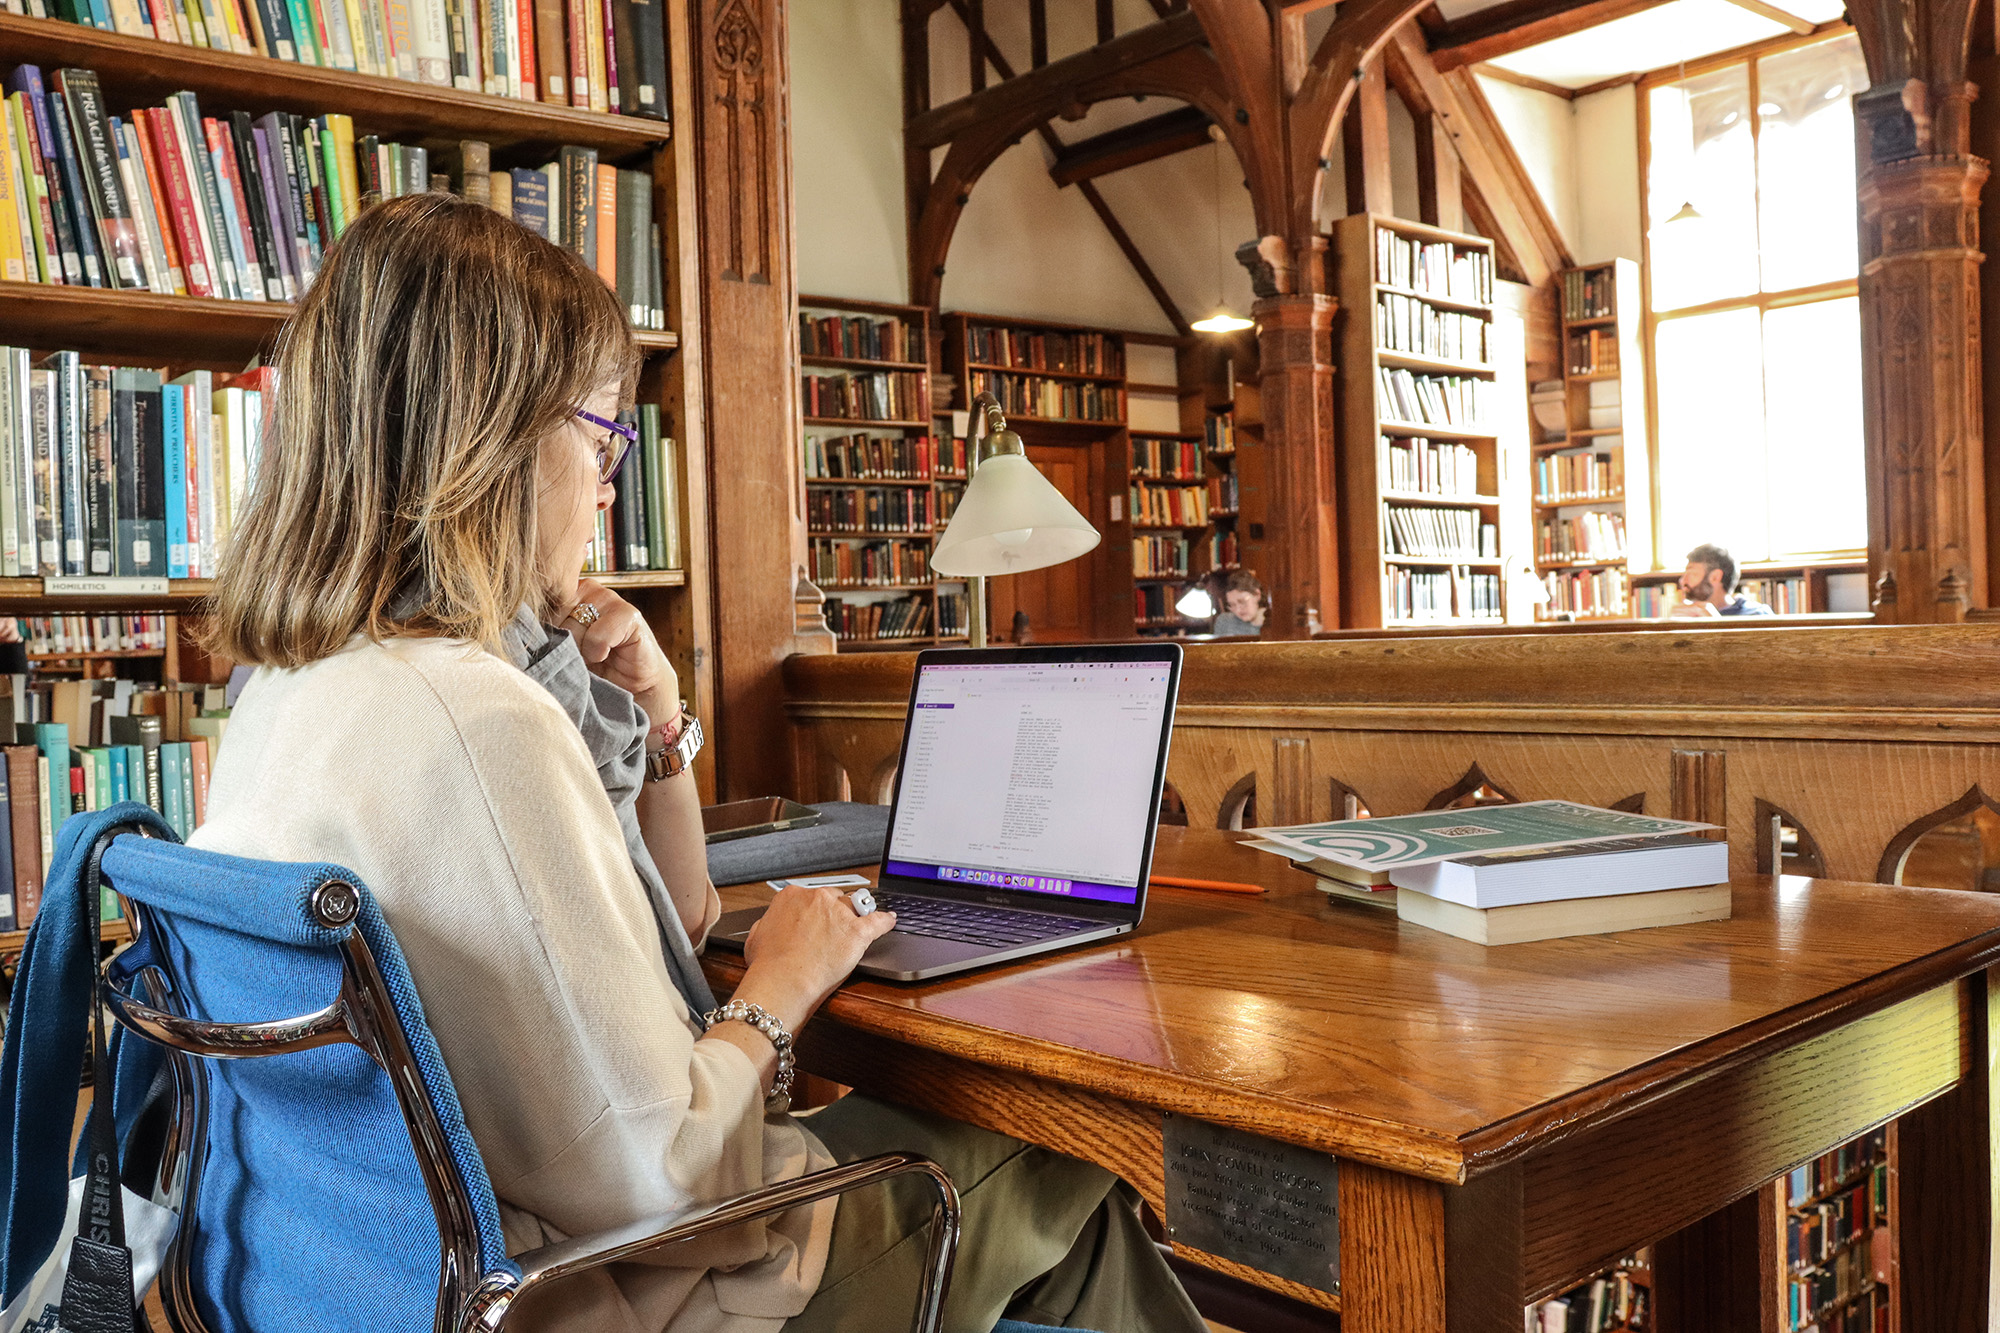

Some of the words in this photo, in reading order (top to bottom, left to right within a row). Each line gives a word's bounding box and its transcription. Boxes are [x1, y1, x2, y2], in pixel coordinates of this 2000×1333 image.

[79, 90, 105, 149] PREACH
[93, 146, 109, 163] the
[279, 125, 289, 142] THE
[282, 142, 295, 175] FUTURE
[574, 155, 586, 170] In
[288, 175, 297, 187] OF
[518, 181, 546, 192] HISTORY
[574, 173, 587, 211] God's
[289, 187, 305, 233] PREACHING
[303, 192, 316, 222] WORD
[574, 213, 587, 254] Name
[34, 394, 49, 456] SCOTLAND
[171, 437, 179, 484] PREACHERS
[147, 748, 158, 770] The
[1628, 820, 1684, 830] USE
[1212, 1136, 1221, 1145] In
[1225, 1139, 1267, 1160] Memory
[1274, 1152, 1284, 1163] of
[1181, 1144, 1211, 1162] JOHN
[1218, 1154, 1263, 1177] COWELL
[1272, 1169, 1323, 1194] BROOKS
[90, 1153, 111, 1245] CHRIS
[1187, 1182, 1222, 1200] Faithful
[1227, 1195, 1254, 1210] Priest
[1260, 1205, 1278, 1219] and
[1284, 1211, 1316, 1229] Pastor
[1236, 1180, 1245, 1191] to
[1273, 1190, 1309, 1209] October
[1181, 1198, 1247, 1227] Vice-Principal
[1251, 1220, 1262, 1232] of
[1267, 1226, 1326, 1252] Cuddesdon
[1223, 1230, 1244, 1243] 1954
[1260, 1241, 1281, 1255] 1961
